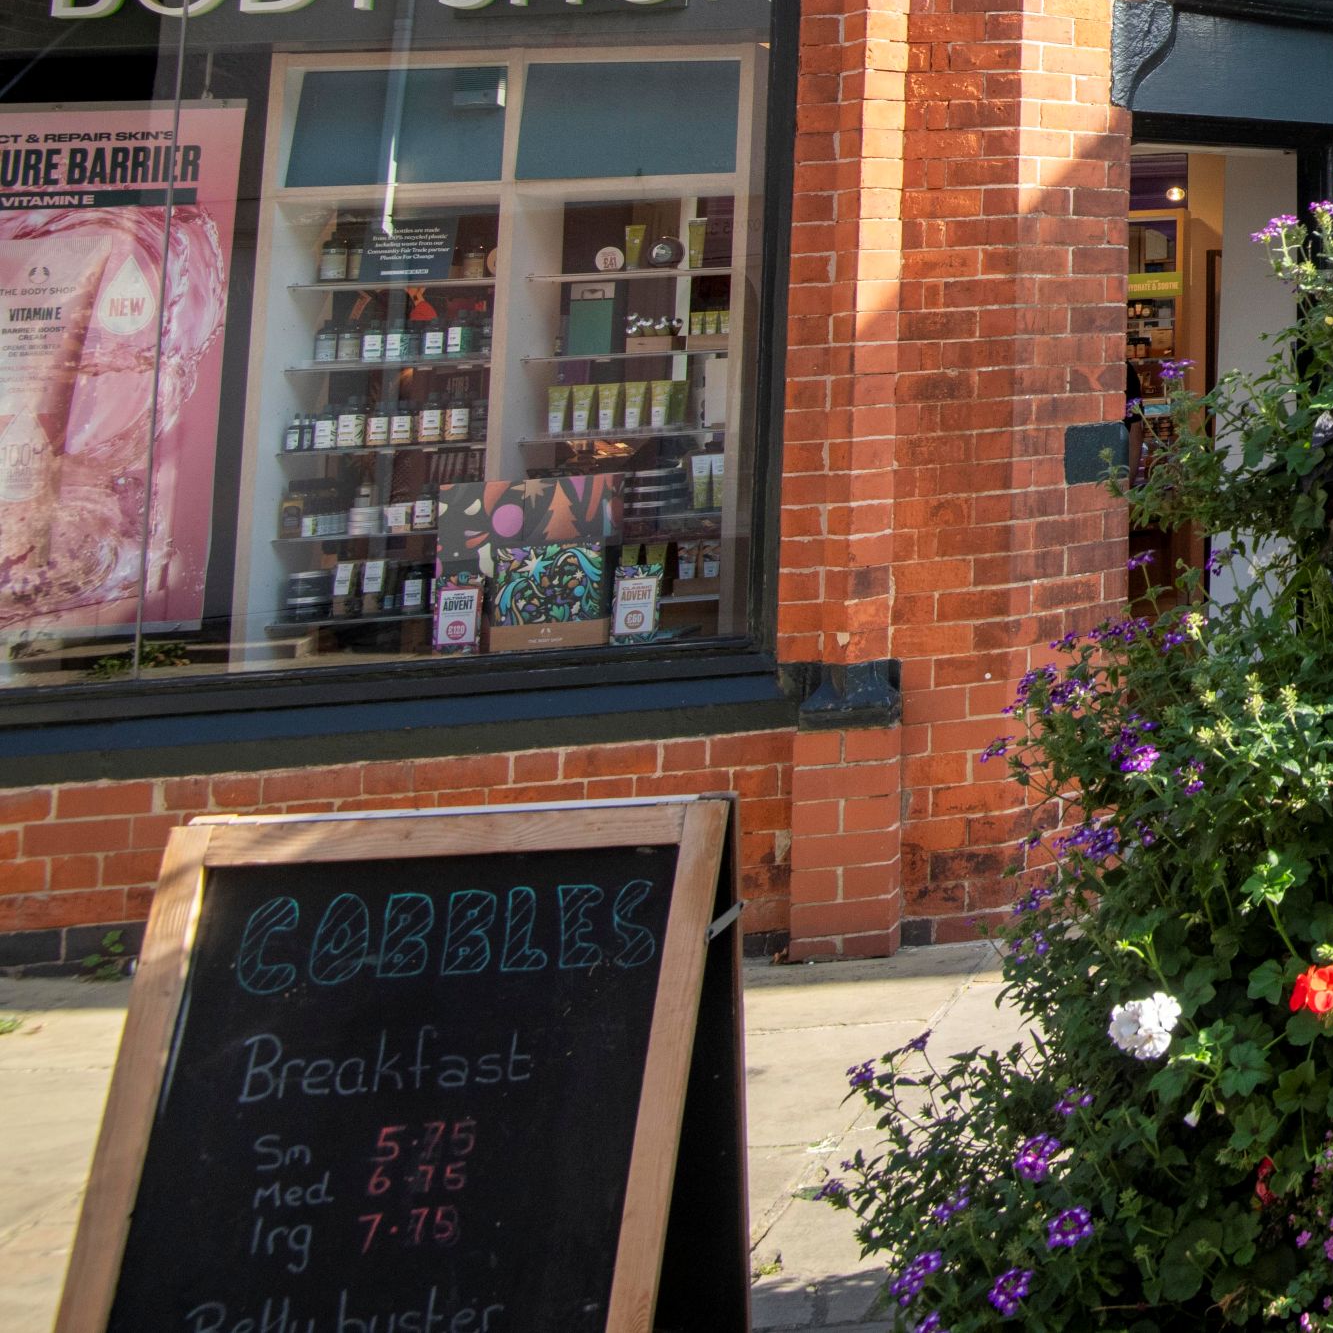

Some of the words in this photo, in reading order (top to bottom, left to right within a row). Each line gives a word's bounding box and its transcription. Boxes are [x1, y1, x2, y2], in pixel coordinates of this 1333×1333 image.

[25, 133, 40, 144] &
[44, 132, 111, 142] REPAIR
[115, 130, 173, 141] SKIN'S
[66, 145, 202, 185] BARRIER
[1, 196, 79, 207] VITAMIN
[82, 194, 95, 205] E
[0, 288, 18, 296] THE
[21, 288, 48, 296] BODY
[49, 286, 76, 295] SHOP
[1158, 282, 1180, 290] SOOTHE
[9, 307, 53, 322] VITAMIN
[55, 306, 62, 320] E
[108, 298, 146, 318] NEW
[622, 590, 652, 601] ADVENT
[442, 599, 474, 612] ADVENT
[237, 879, 656, 994] COBBLES
[238, 1025, 533, 1104] Breakfast
[253, 1134, 312, 1170] Sm
[253, 1171, 334, 1209] Med
